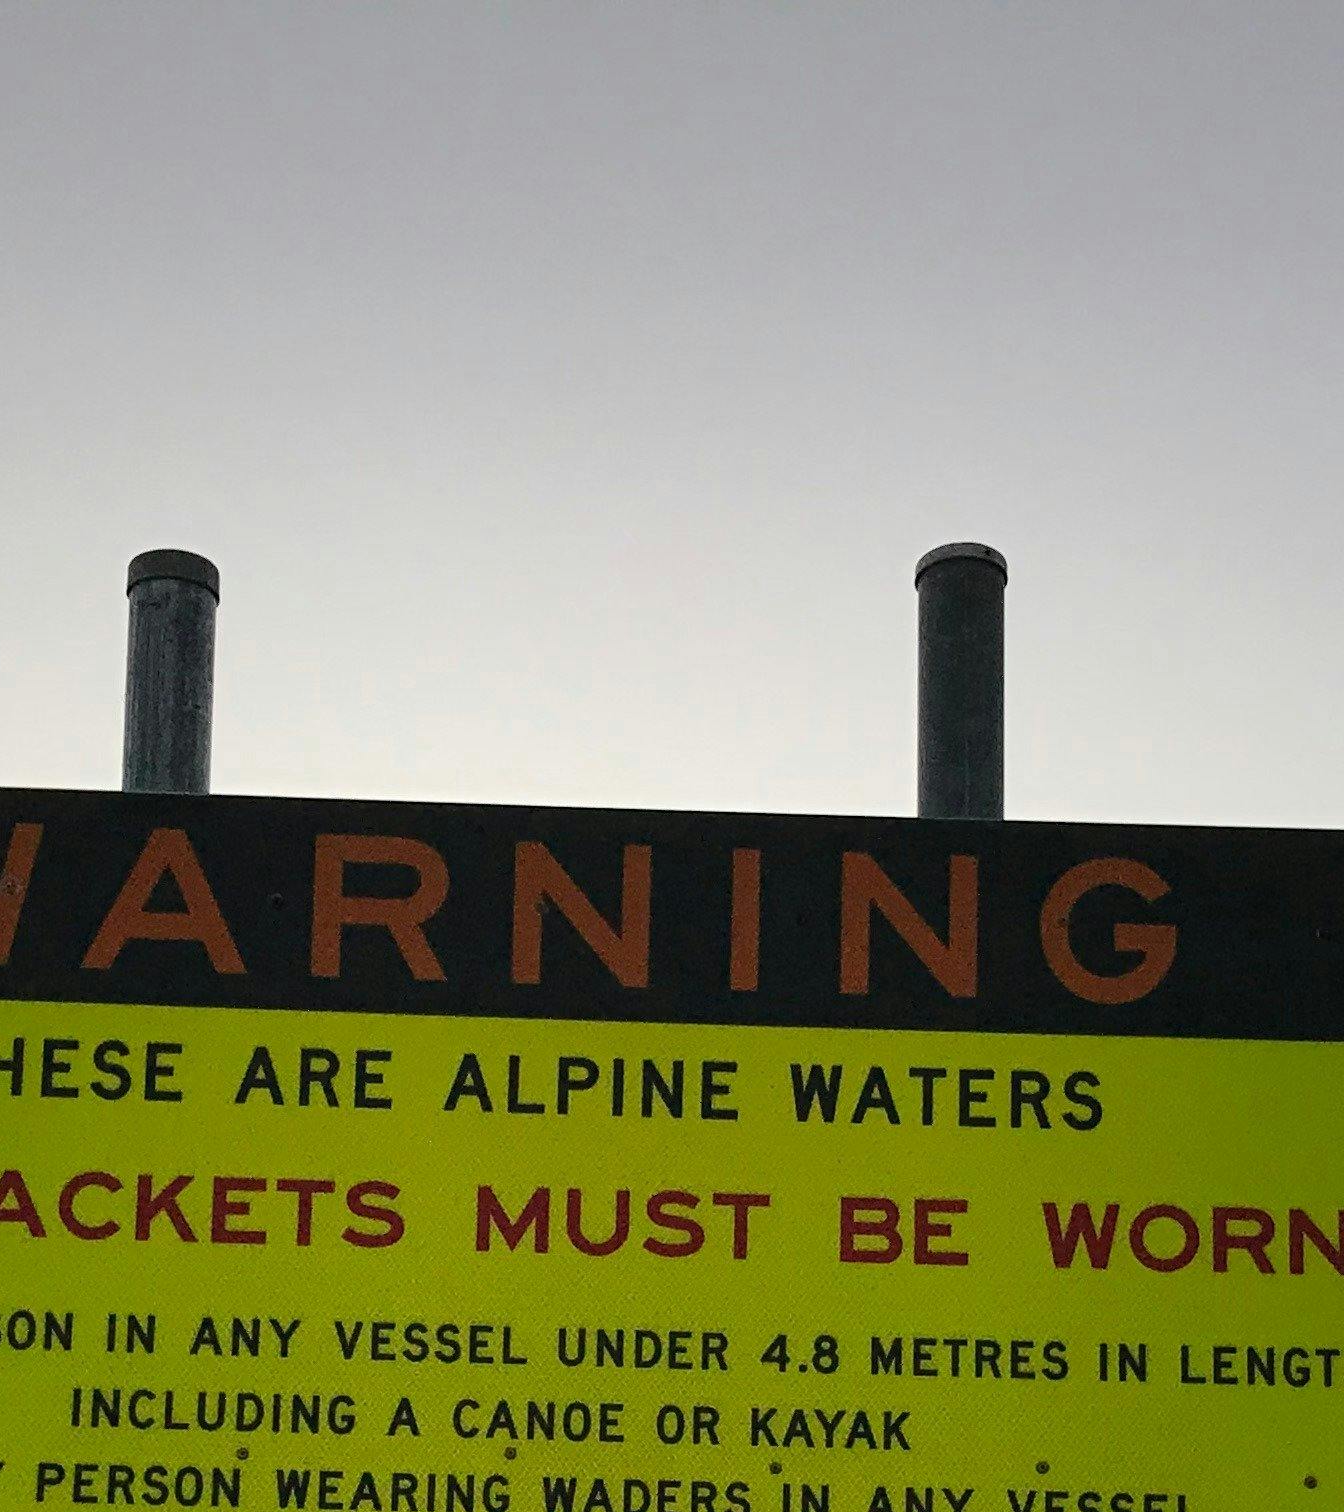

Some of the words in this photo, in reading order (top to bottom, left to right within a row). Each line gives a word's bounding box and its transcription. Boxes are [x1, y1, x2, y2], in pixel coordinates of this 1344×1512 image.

[234, 1046, 394, 1109] ARE
[444, 1053, 738, 1120] ALPINE
[790, 1063, 1104, 1129] WATERS
[475, 1186, 770, 1259] MUST
[840, 1197, 969, 1265] BE
[105, 1314, 156, 1354] IN
[190, 1316, 301, 1358] ANY
[337, 1323, 527, 1366] VESSEL
[558, 1329, 729, 1371] UNDER
[760, 1334, 840, 1373] 4.8
[870, 1336, 1068, 1381] METRES
[1098, 1344, 1151, 1382] IN
[70, 1388, 357, 1434] INCLUDING
[388, 1398, 421, 1436] A
[453, 1400, 625, 1442] CANOE
[656, 1406, 720, 1445] OR
[750, 1408, 911, 1450] KAYAK
[35, 1463, 243, 1507] PERSON
